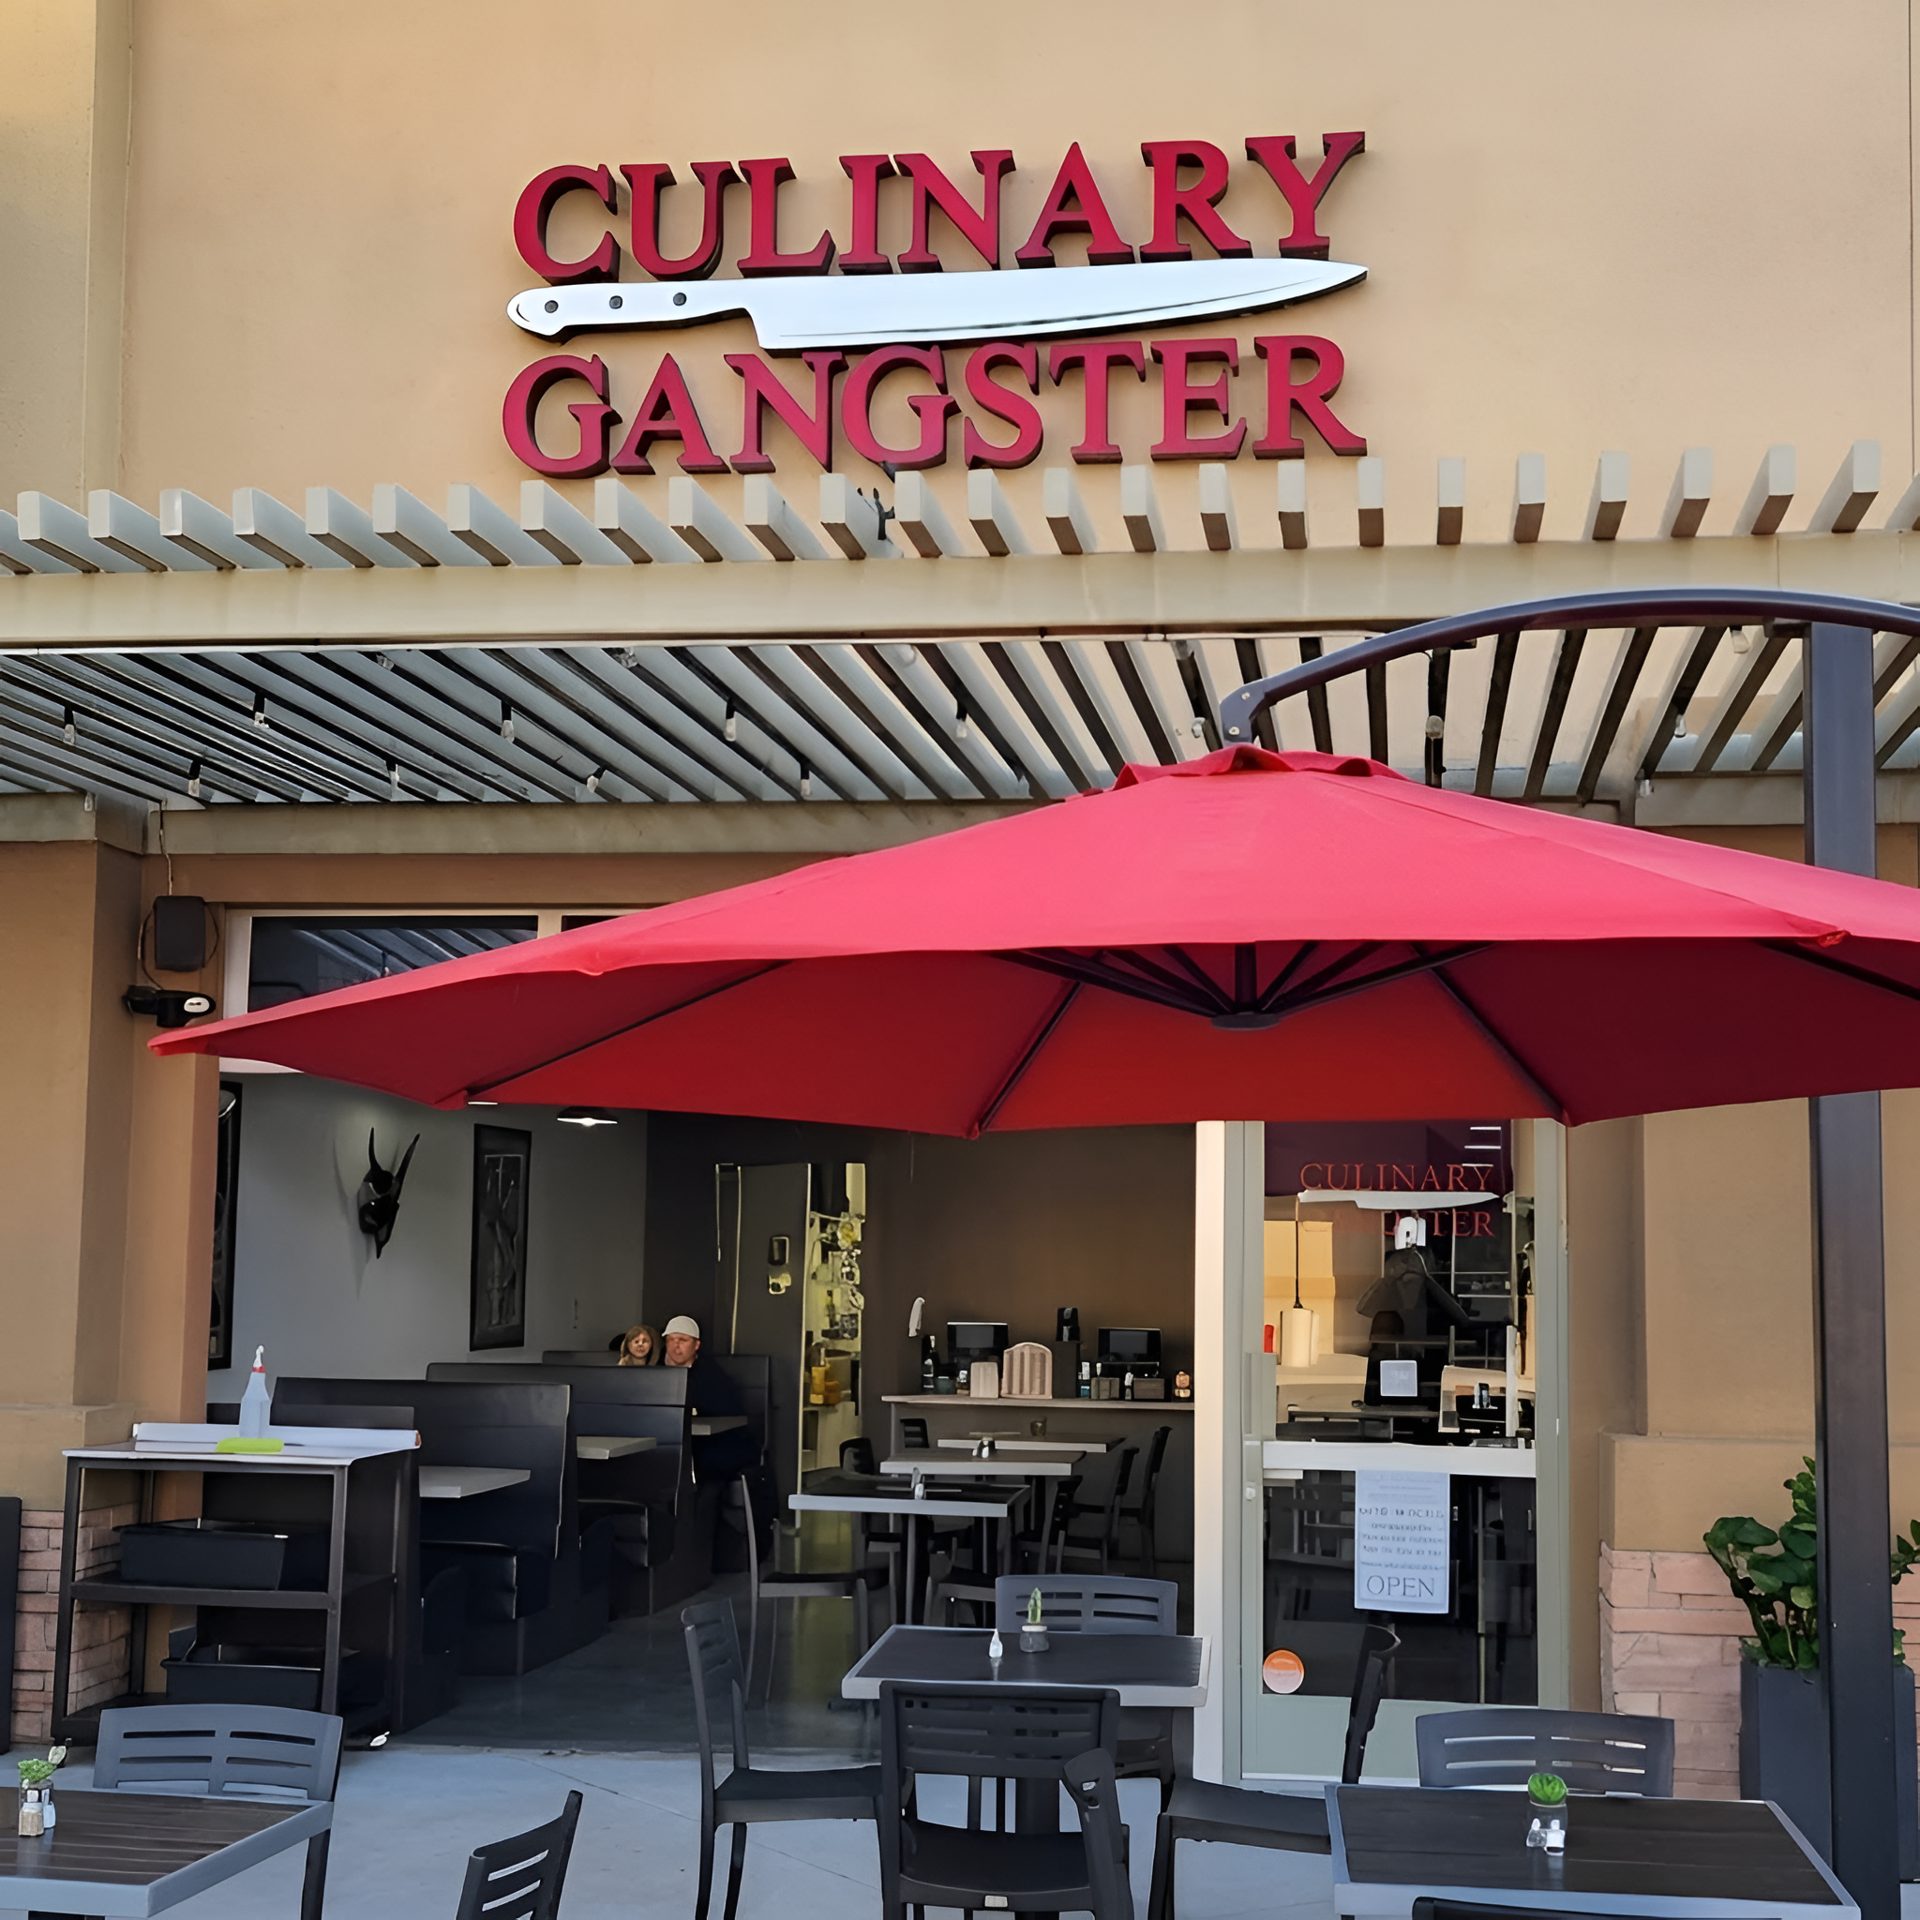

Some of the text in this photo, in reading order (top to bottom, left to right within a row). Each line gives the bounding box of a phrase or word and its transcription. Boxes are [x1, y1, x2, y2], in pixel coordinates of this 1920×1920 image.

[512, 131, 1367, 285] CULINARY
[502, 335, 1368, 478] GANGSTER
[1300, 1162, 1494, 1191] CULINARY
[1366, 1575, 1435, 1597] OPEN
